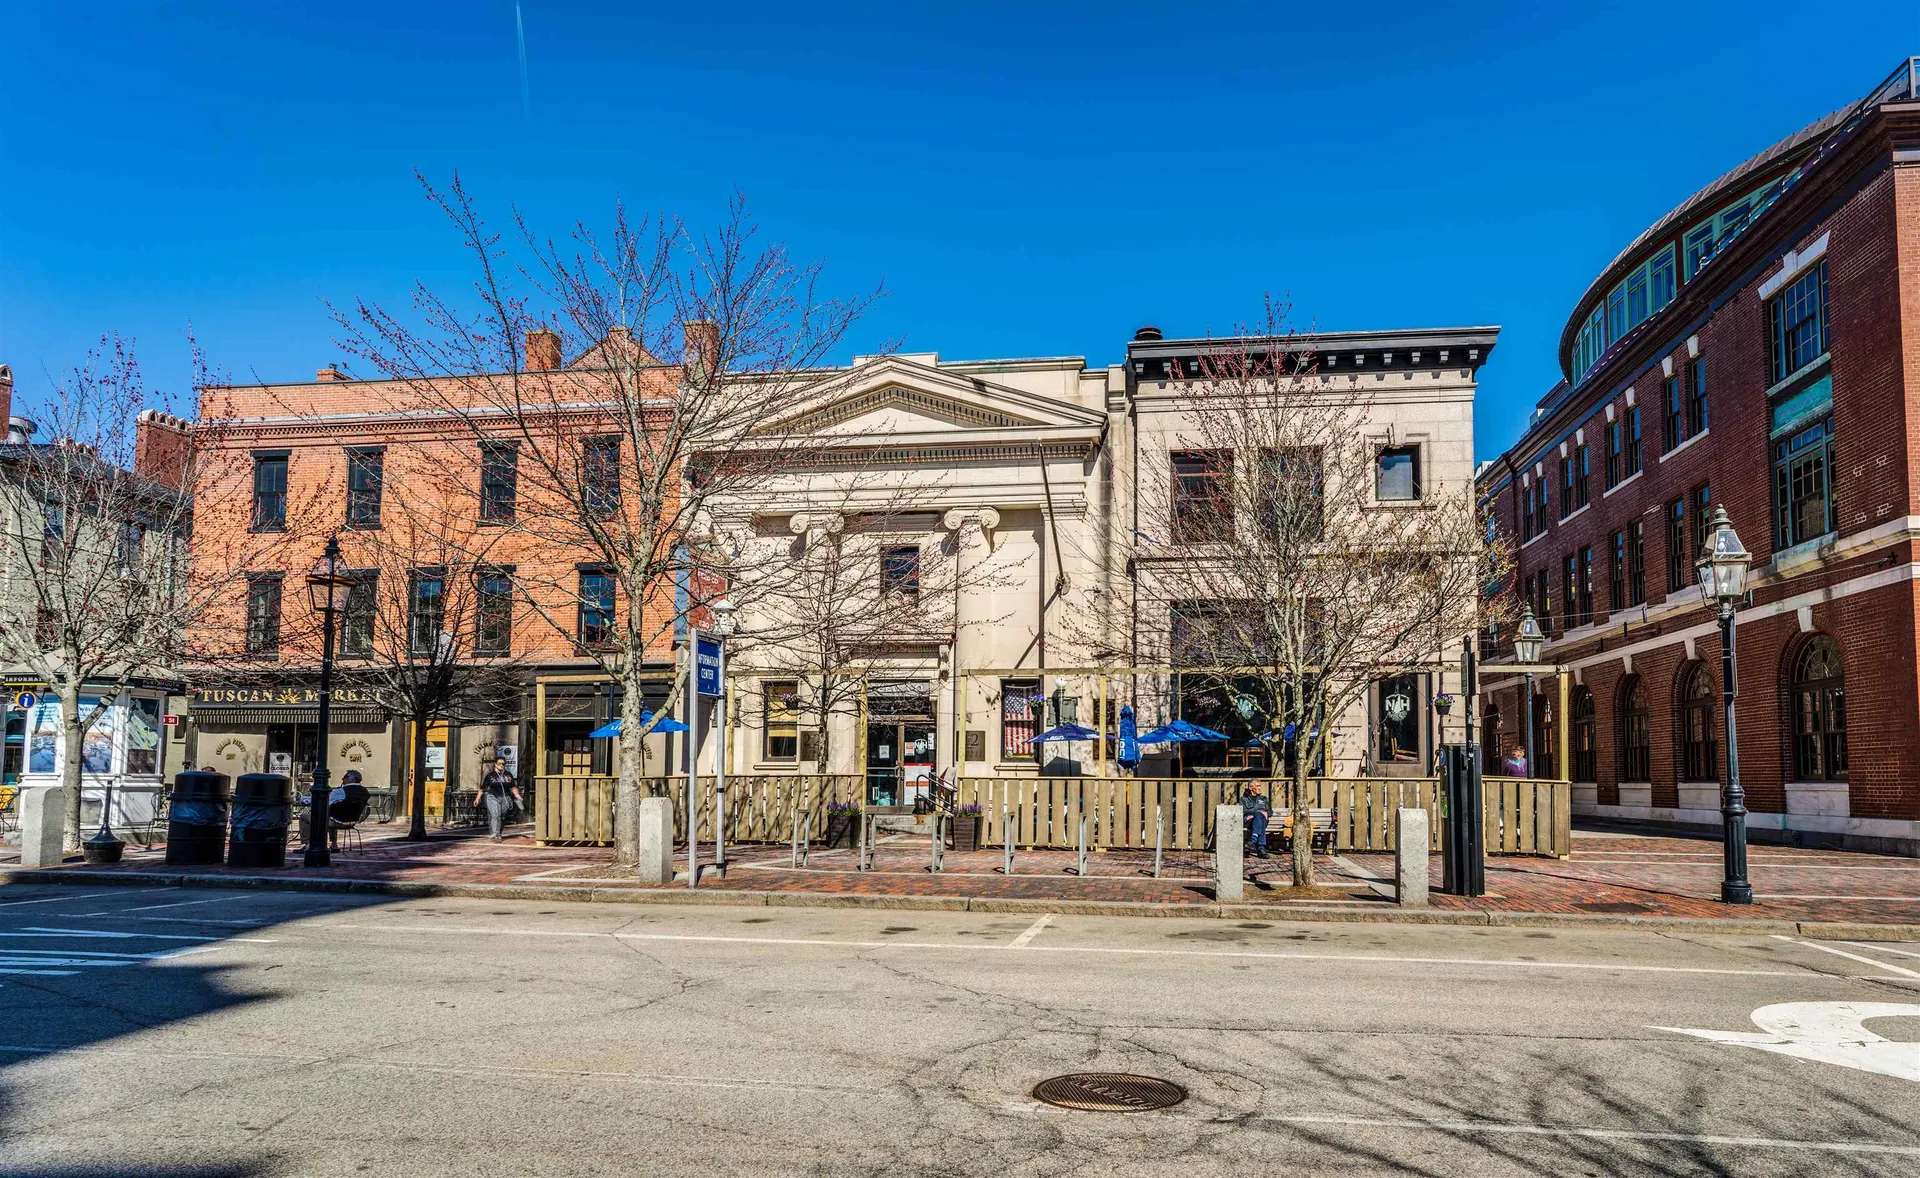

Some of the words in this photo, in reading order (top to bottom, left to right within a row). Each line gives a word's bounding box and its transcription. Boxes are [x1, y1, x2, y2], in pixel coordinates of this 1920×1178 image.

[698, 653, 719, 667] NFORMATION
[701, 667, 714, 680] CENTER
[202, 689, 274, 702] TUSCAN
[304, 688, 382, 702] MRKET
